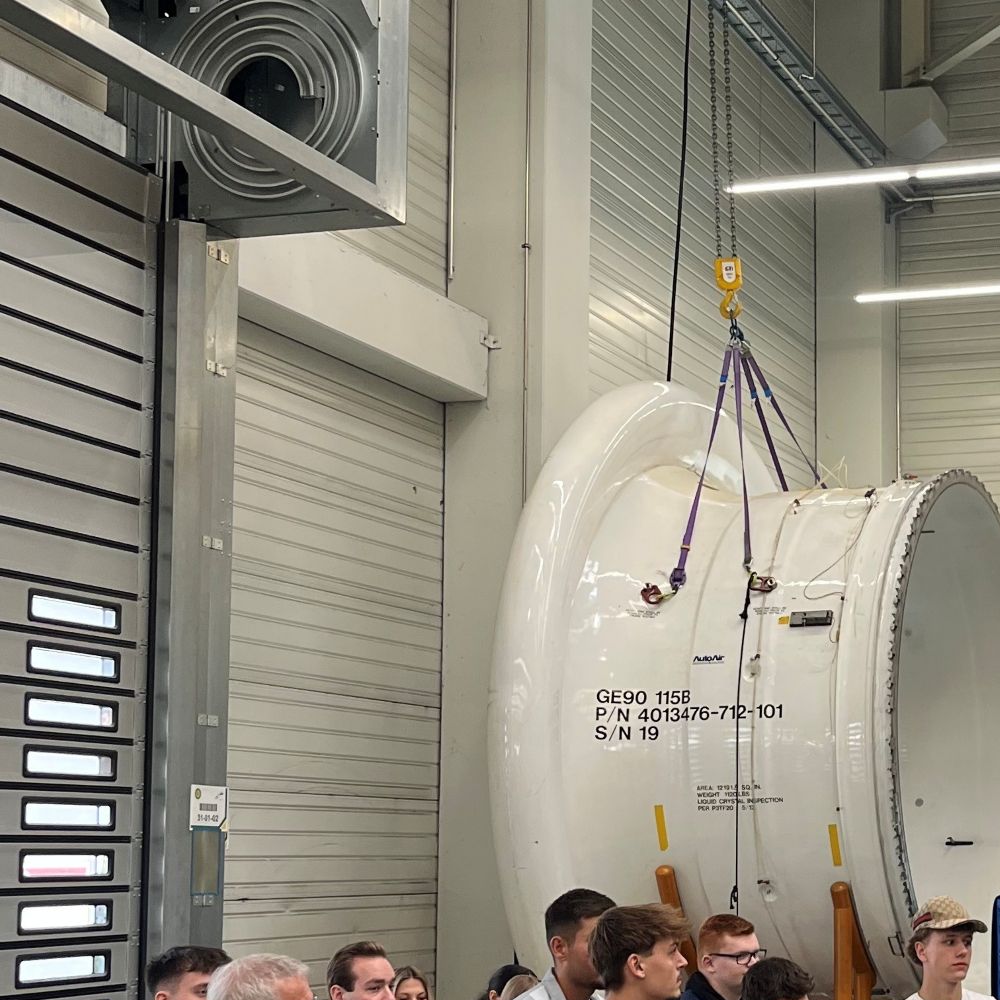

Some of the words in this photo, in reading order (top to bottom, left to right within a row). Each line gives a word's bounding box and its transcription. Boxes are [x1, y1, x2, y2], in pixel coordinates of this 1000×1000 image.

[693, 655, 725, 663] AutoAir
[596, 689, 647, 704] GE90
[656, 690, 690, 705] 115B
[595, 706, 630, 723] P/N
[638, 704, 784, 722] 4013476-712-101
[595, 724, 631, 741] S/N
[640, 726, 659, 740] 19
